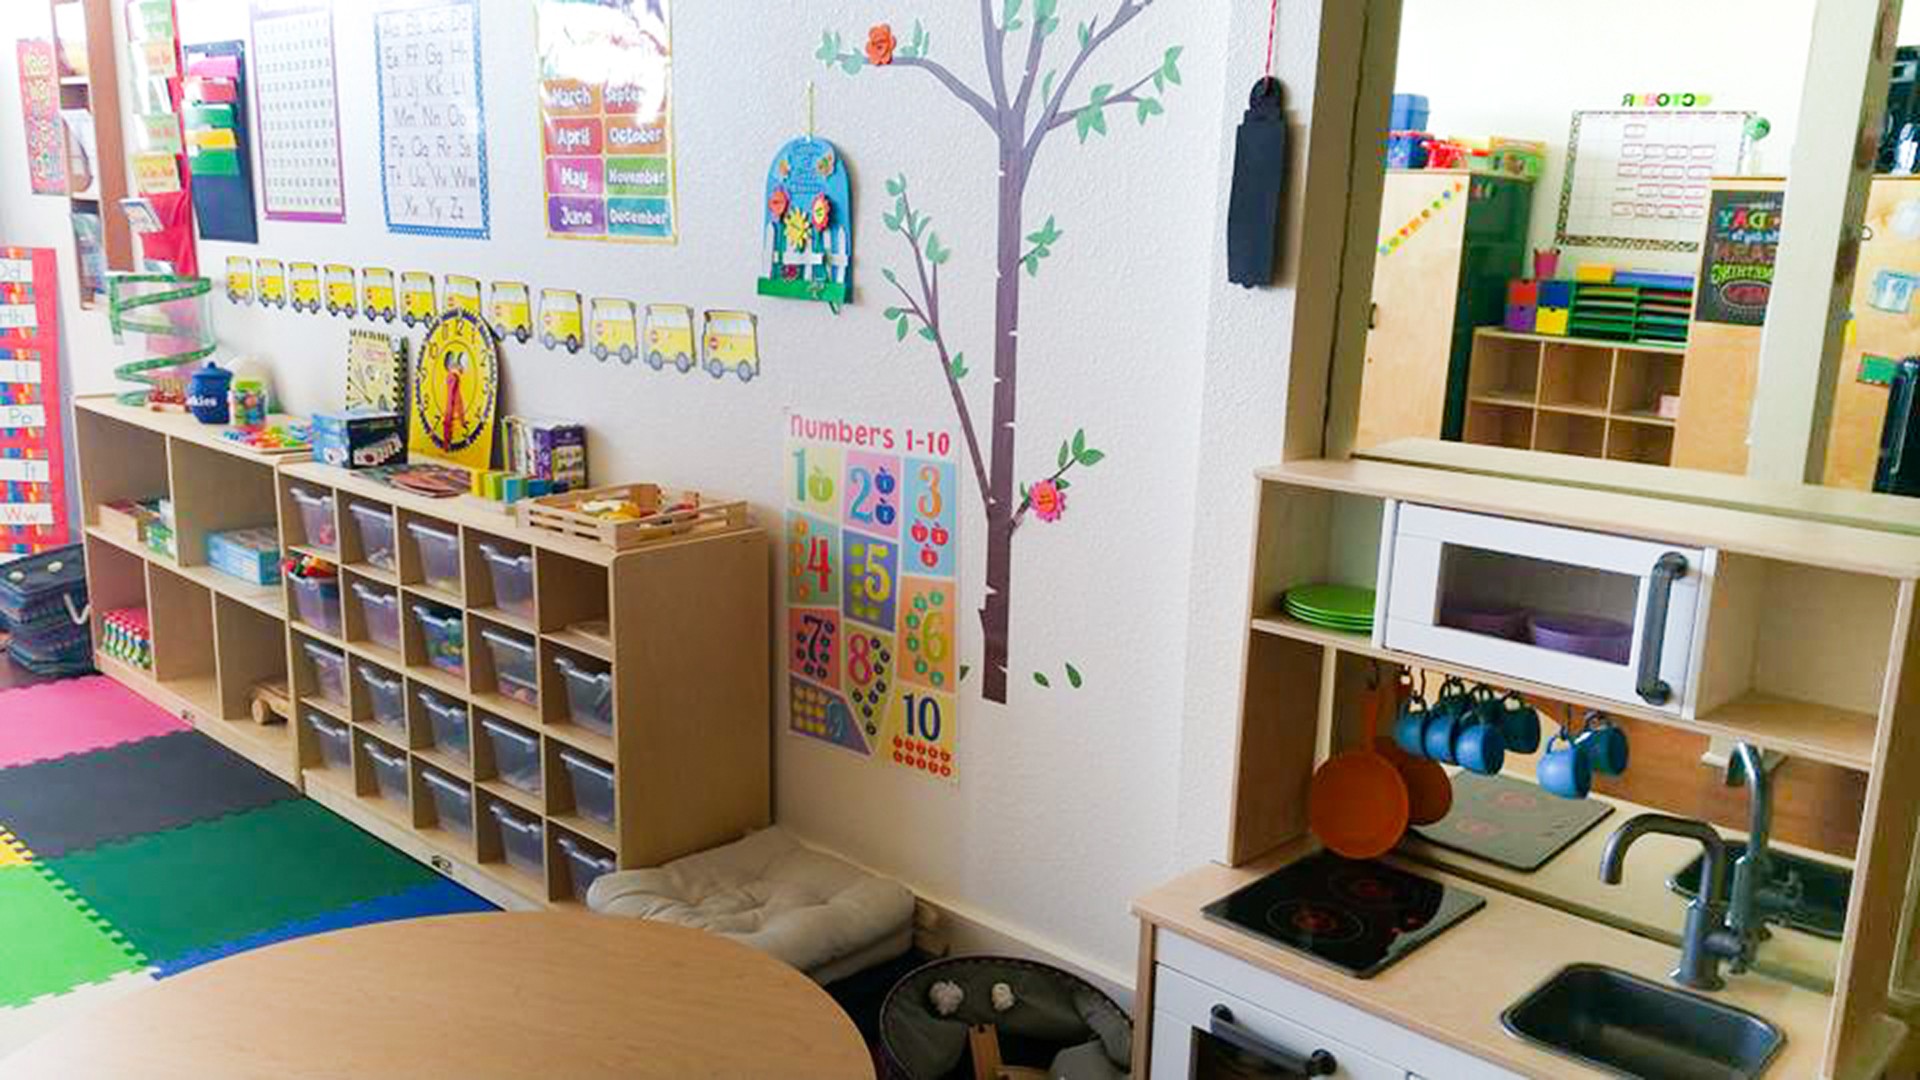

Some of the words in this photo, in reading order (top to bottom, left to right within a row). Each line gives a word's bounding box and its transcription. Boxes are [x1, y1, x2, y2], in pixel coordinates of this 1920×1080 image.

[550, 86, 591, 107] March
[557, 127, 591, 151] April
[608, 126, 662, 144] October
[560, 167, 588, 190] May
[608, 168, 666, 185] November
[560, 207, 593, 225] June
[609, 208, 670, 225] December
[905, 428, 950, 456] 1-10
[792, 449, 806, 502] 1
[850, 465, 873, 523] 2
[918, 465, 942, 519] 3
[807, 535, 832, 593] 4
[865, 543, 891, 602] 5
[803, 614, 823, 663] 7
[923, 608, 948, 663] 6
[848, 633, 873, 686] 8
[827, 699, 847, 744] 9
[903, 693, 941, 741] 10
